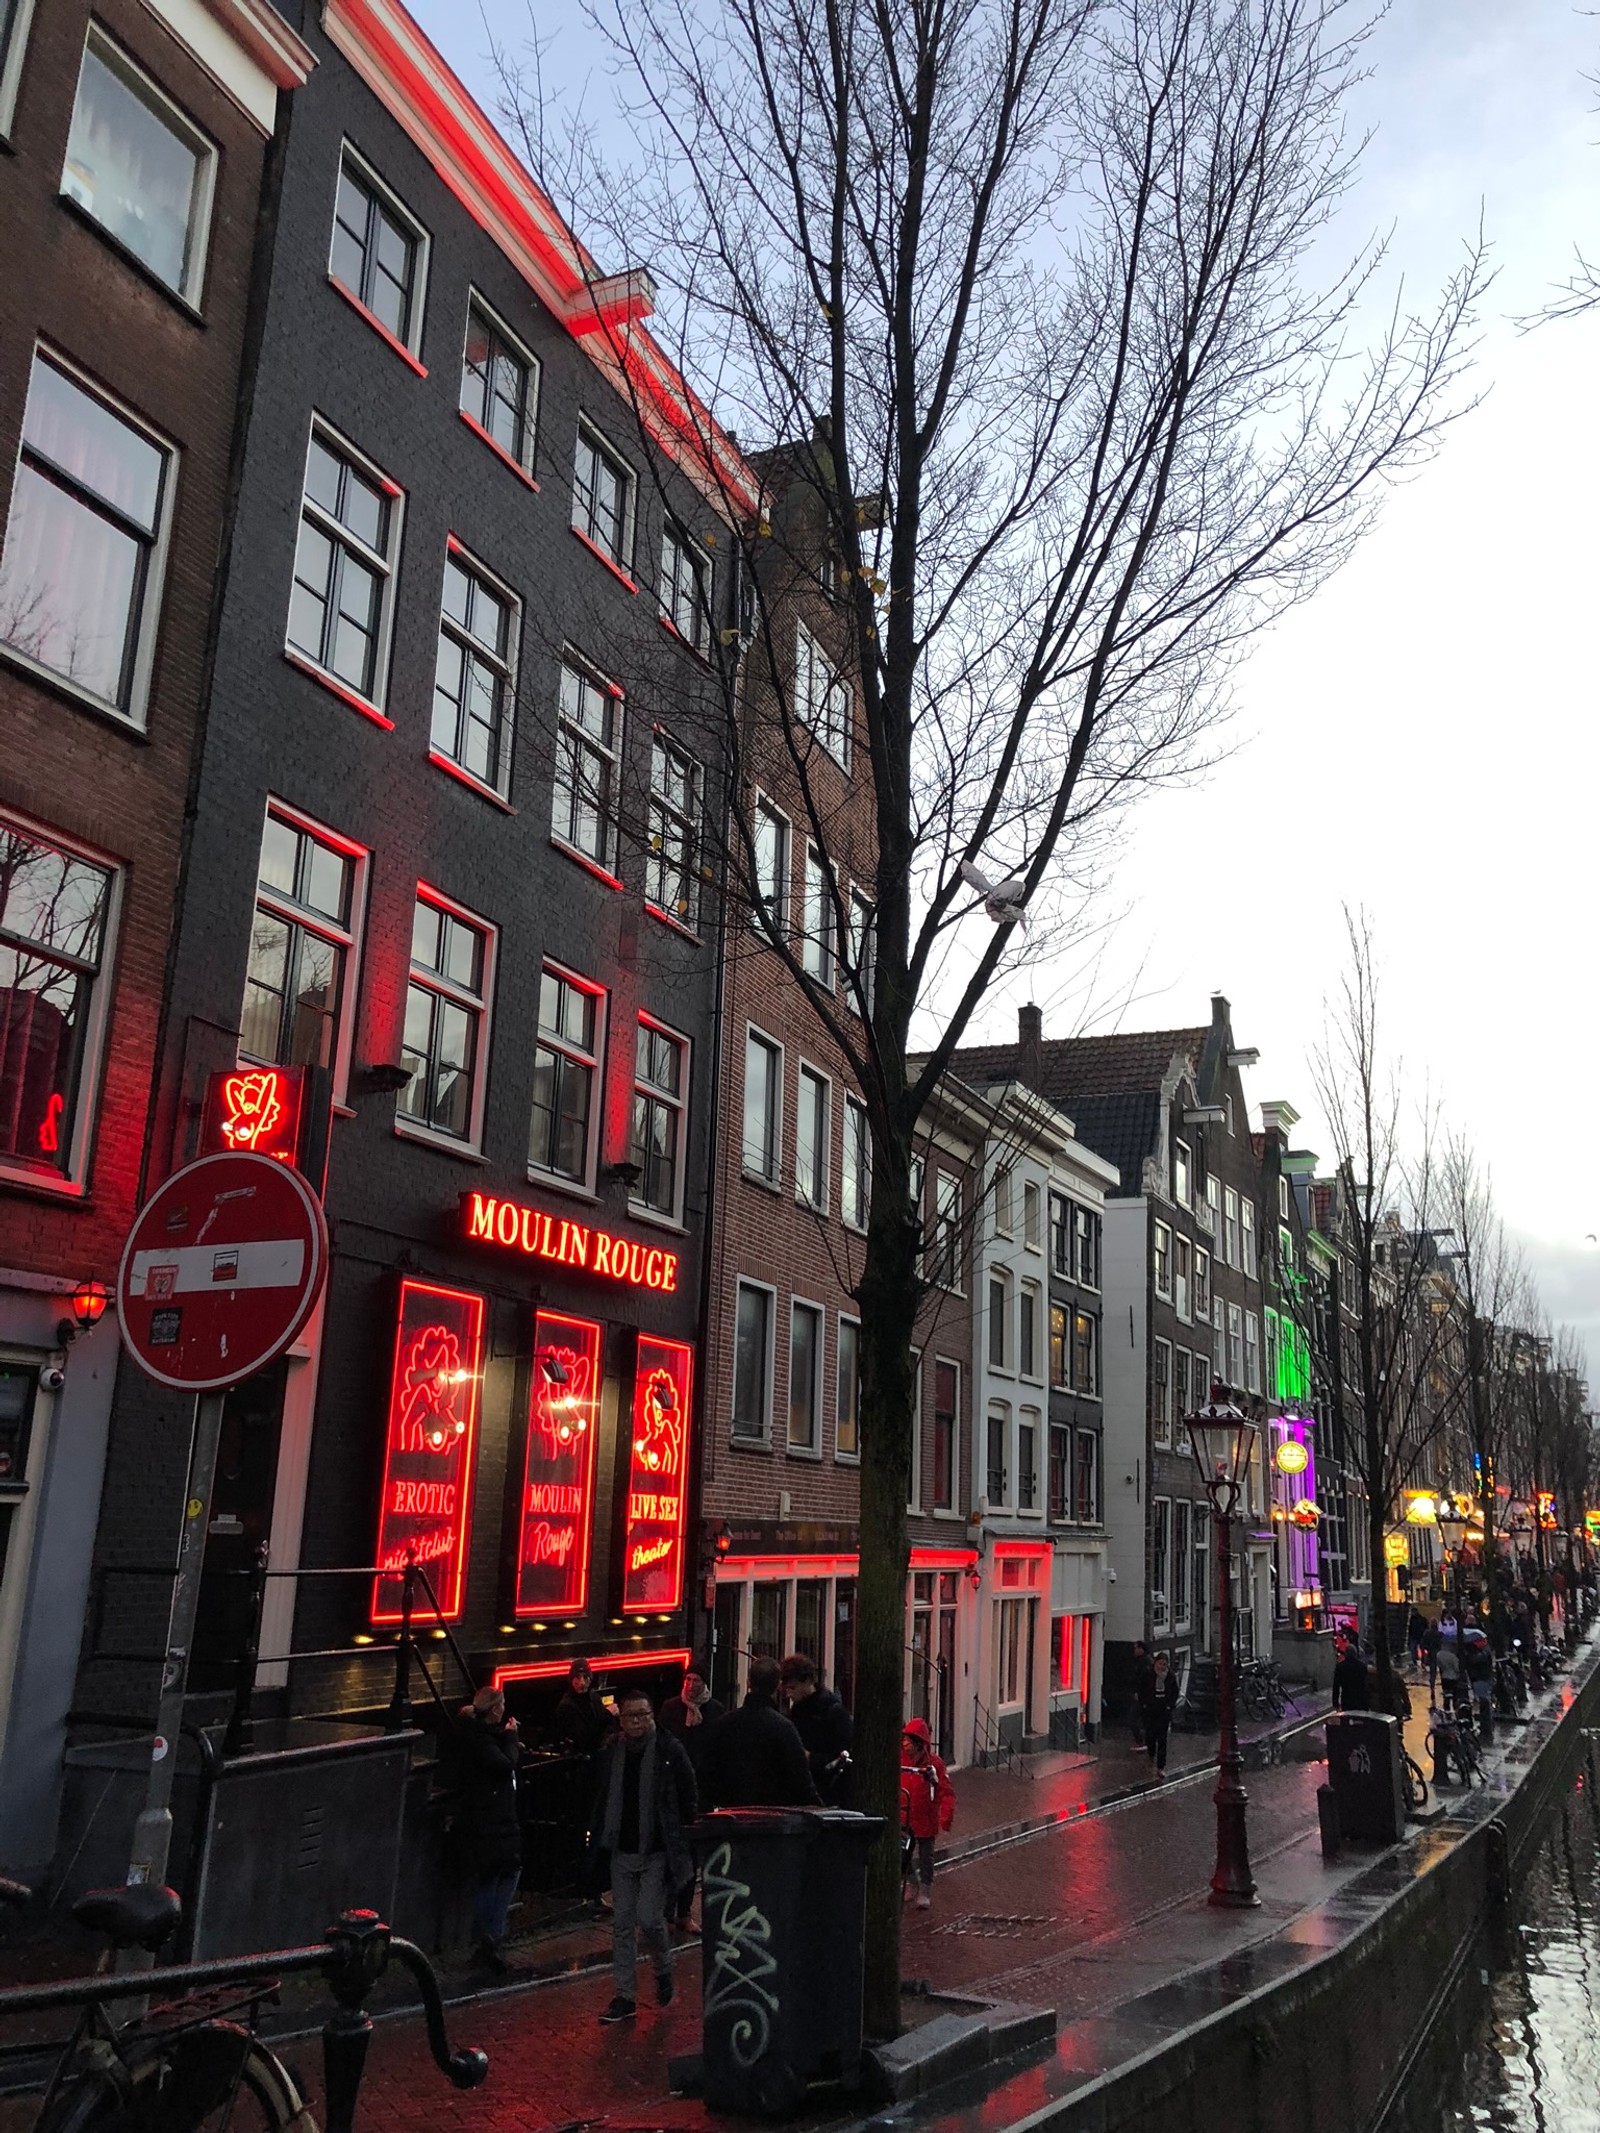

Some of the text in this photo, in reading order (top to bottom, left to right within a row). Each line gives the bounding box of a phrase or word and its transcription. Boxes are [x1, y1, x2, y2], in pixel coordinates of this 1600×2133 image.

[470, 1193, 677, 1292] MOULIN ROUGE
[393, 1481, 455, 1515] EROTIC
[529, 1484, 582, 1513] MOULIN
[631, 1494, 679, 1520] LIVE SEX
[533, 1521, 574, 1566] Rouge
[632, 1537, 673, 1569] theater
